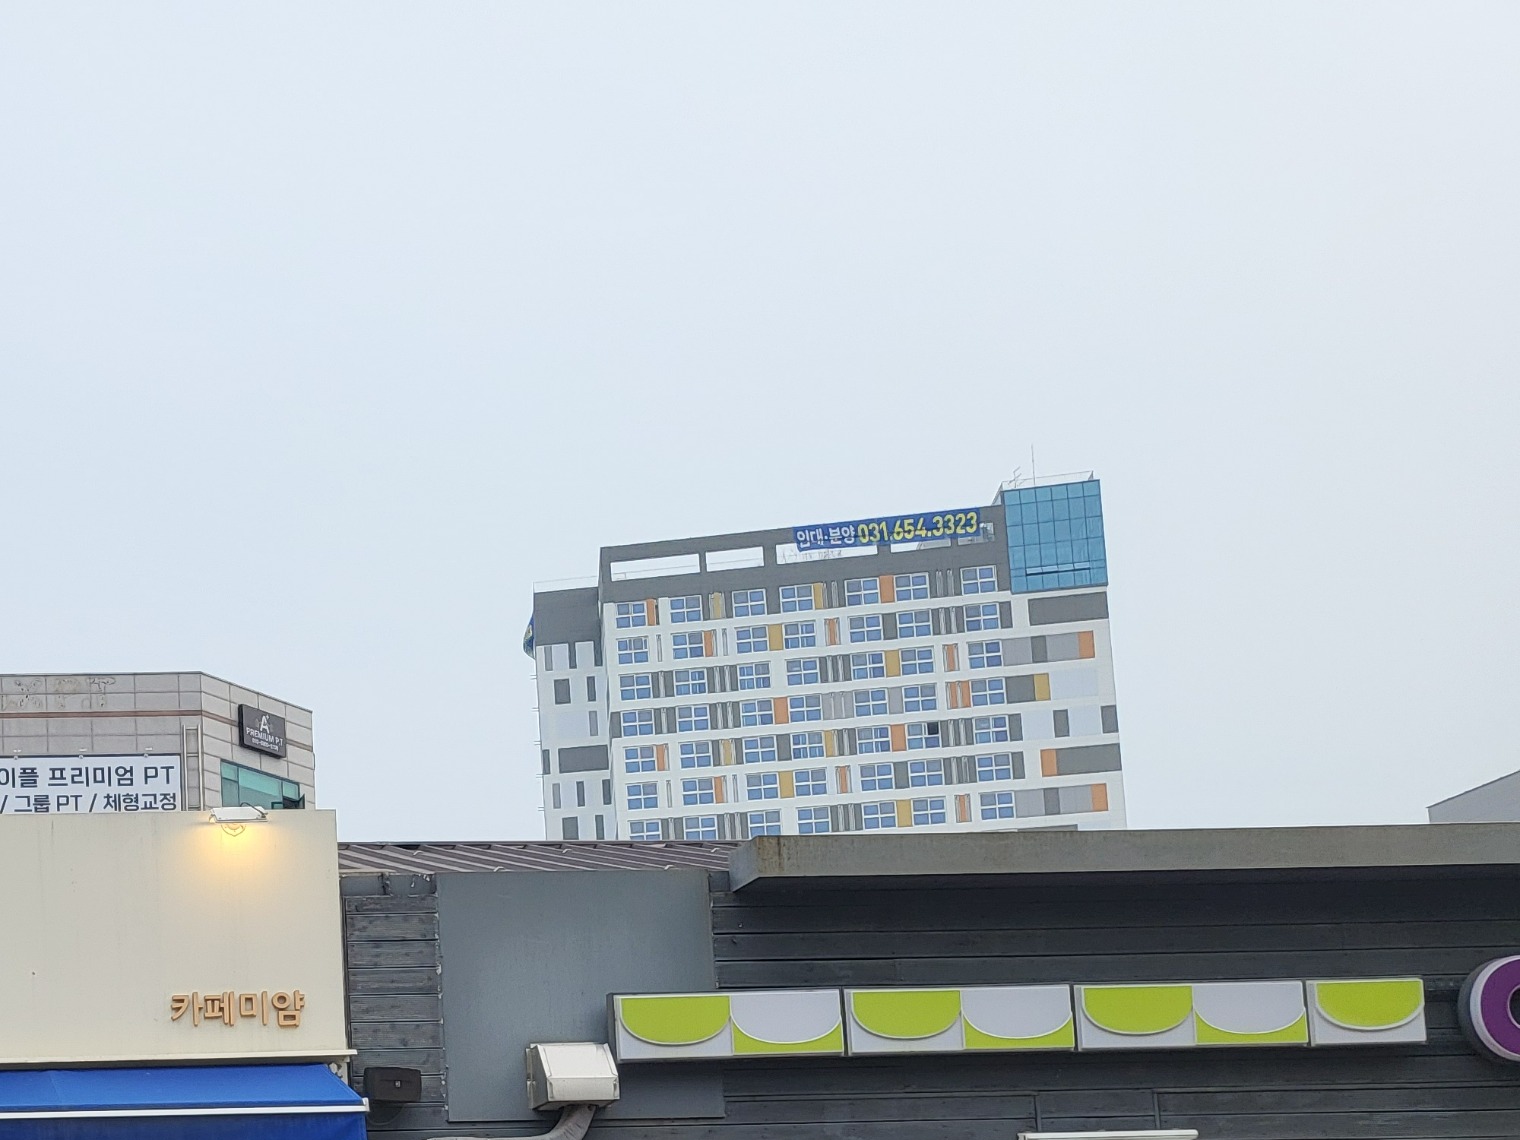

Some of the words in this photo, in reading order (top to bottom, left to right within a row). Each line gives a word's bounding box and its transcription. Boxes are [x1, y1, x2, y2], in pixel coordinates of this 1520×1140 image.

[857, 511, 978, 544] 031.654.3323
[246, 727, 274, 743] PREMIUM
[47, 765, 134, 788] 프리미엄
[144, 765, 175, 785] PT
[14, 794, 51, 813] 그룹
[56, 795, 83, 812] PT
[103, 792, 177, 812] 체형교정
[170, 989, 306, 1028] 카페미얌
